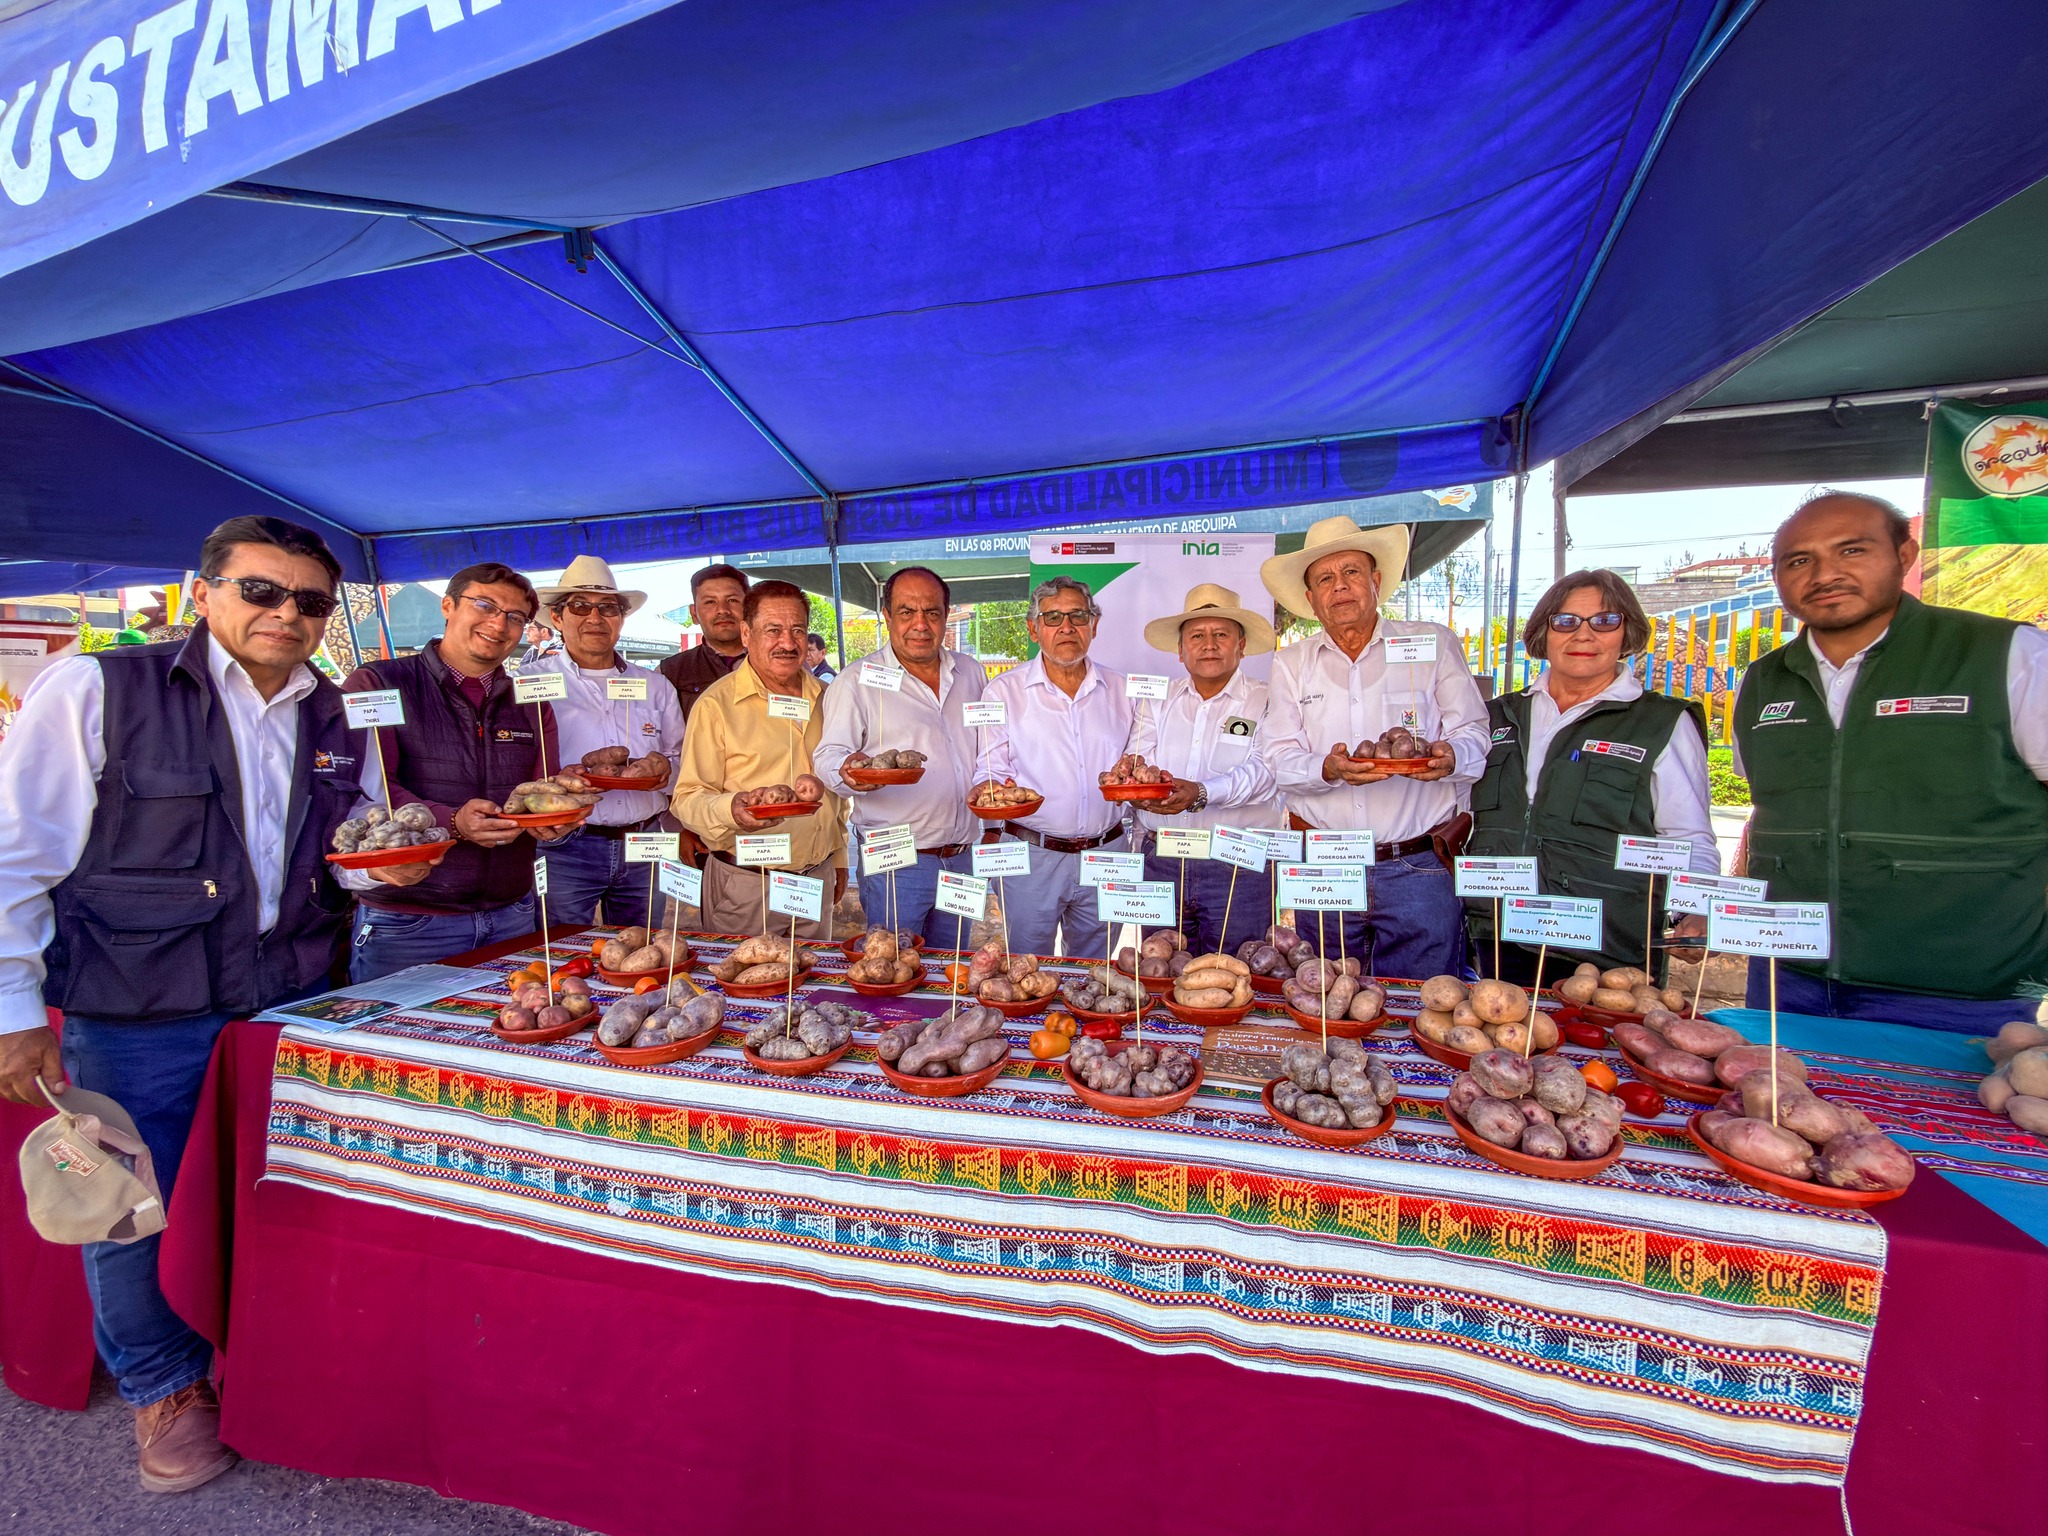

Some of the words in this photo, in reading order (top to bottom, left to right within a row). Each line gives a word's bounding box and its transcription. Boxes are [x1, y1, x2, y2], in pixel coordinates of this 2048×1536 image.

[0, 0, 502, 206] USTAMA
[1181, 515, 1237, 533] AREQUIPA
[946, 540, 959, 551] EN
[961, 539, 978, 551] LAS
[980, 540, 992, 551] 08
[994, 538, 1030, 550] PROVIN
[1183, 540, 1219, 555] inia
[1156, 885, 1171, 893] inia
[1740, 885, 1760, 893] inia
[1670, 898, 1697, 908] PUCA
[958, 905, 974, 913] NEGRO
[1577, 904, 1598, 913] inia
[1114, 911, 1160, 919] WUANCUCHO
[1801, 909, 1824, 918] inia
[1545, 931, 1591, 941] ALTIPLANO
